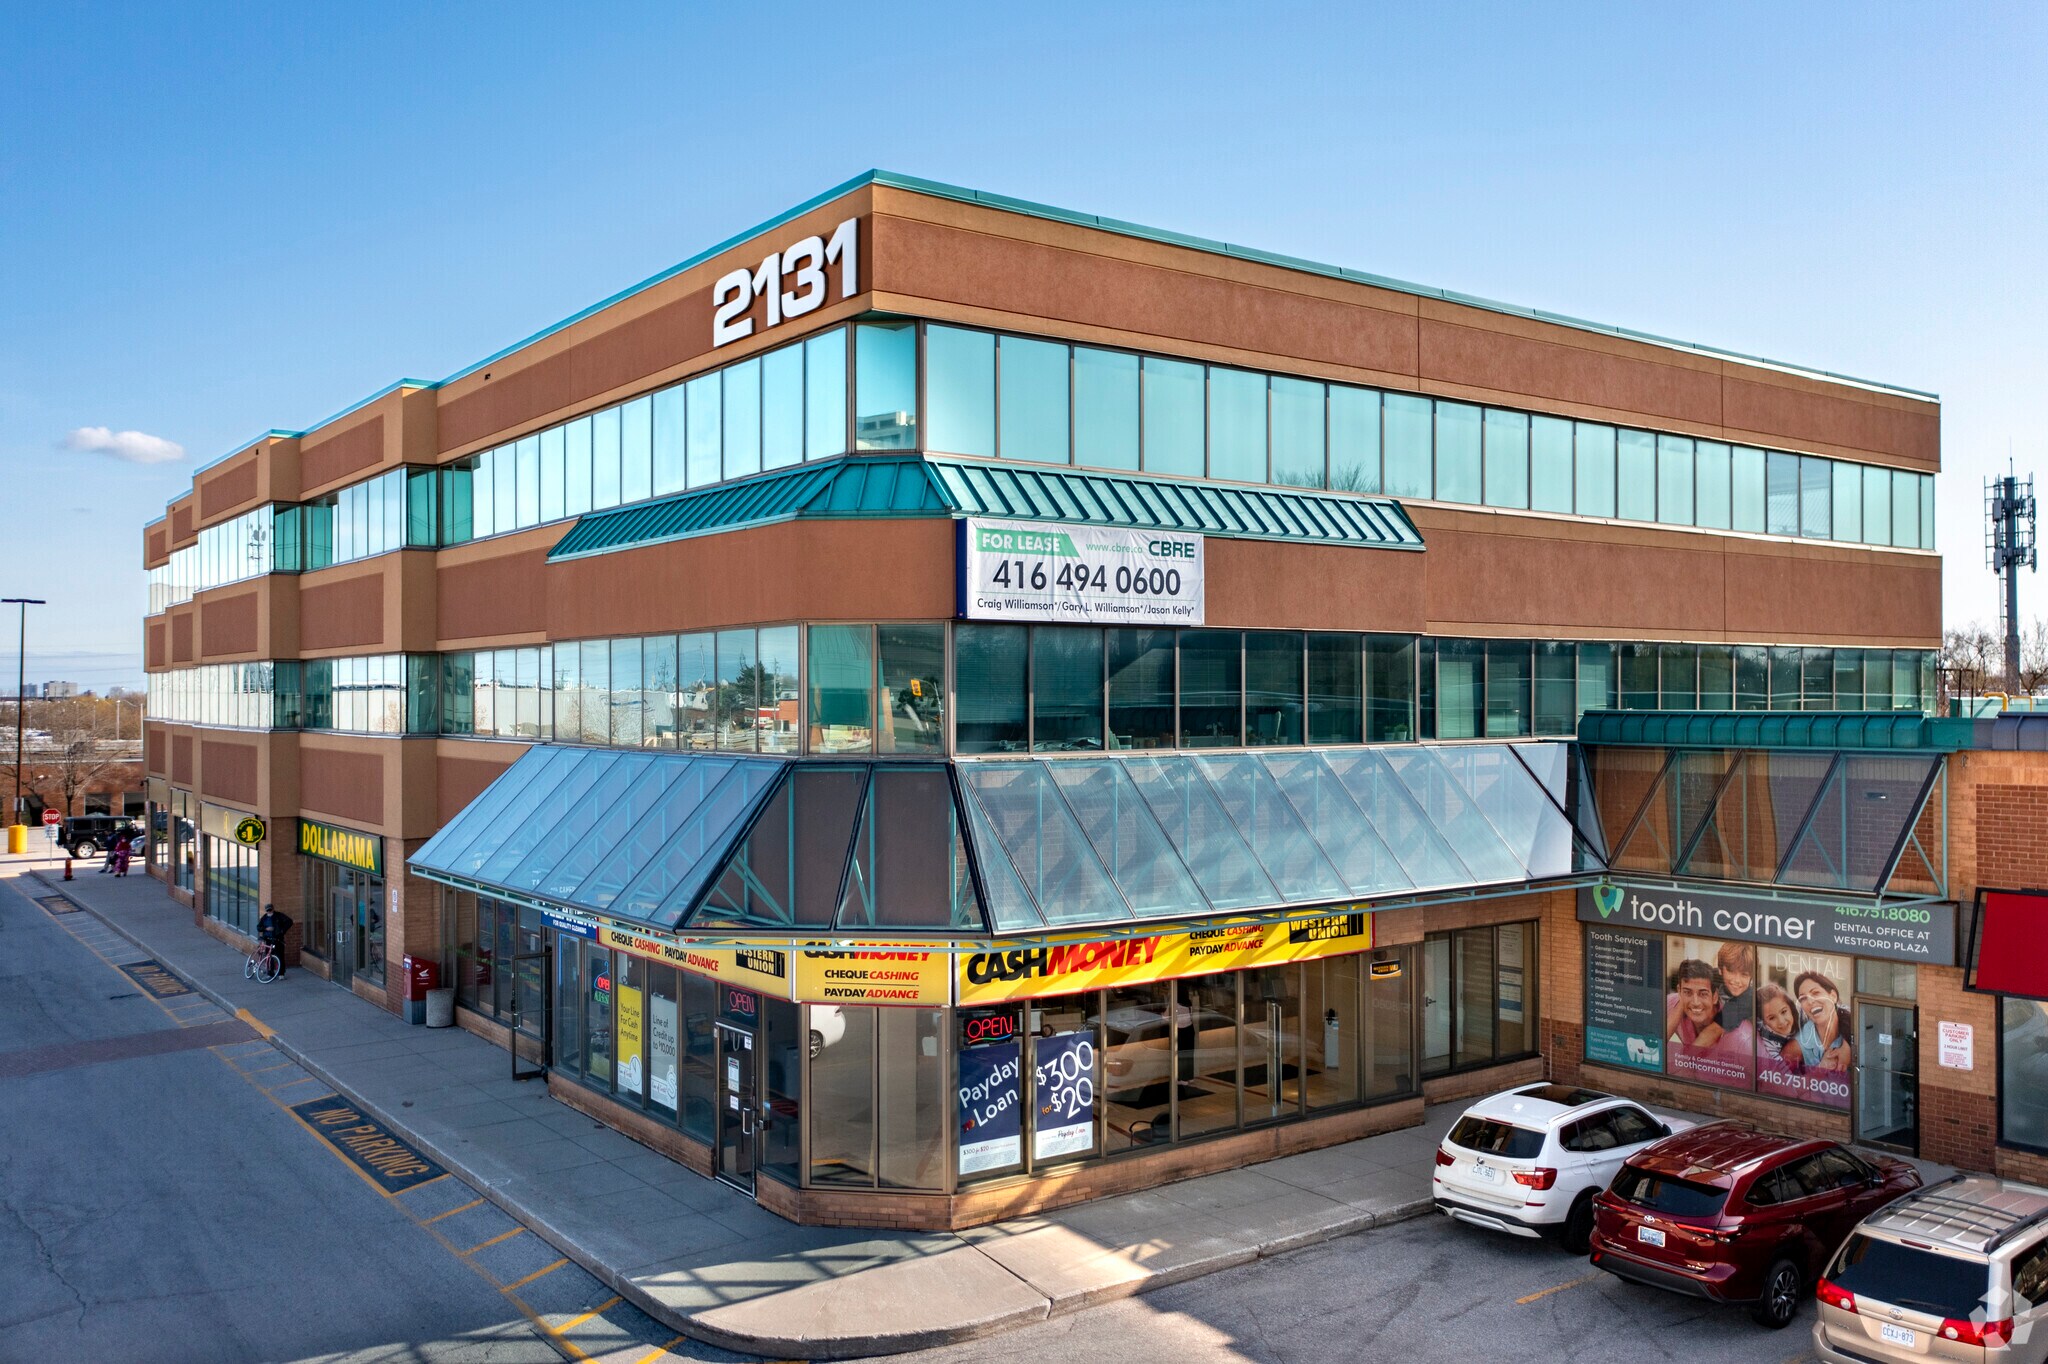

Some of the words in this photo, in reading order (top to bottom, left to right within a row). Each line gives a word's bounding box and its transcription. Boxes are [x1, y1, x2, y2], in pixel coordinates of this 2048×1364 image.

[713, 217, 858, 348] 2131
[982, 533, 1013, 549] FOR
[1017, 535, 1061, 552] LEASE
[1149, 540, 1195, 558] CBRE
[992, 560, 1047, 590] 416
[1056, 562, 1107, 593] 494
[1115, 565, 1181, 596] 0600
[977, 598, 1002, 611] Craig
[302, 823, 375, 871] DOLLARAMA
[1290, 914, 1348, 931] WESTERN
[1631, 895, 1702, 928] tooth
[1713, 909, 1815, 940] corner
[1189, 929, 1225, 940] CHEQUE
[1227, 924, 1264, 936] CASHING
[1308, 924, 1348, 940] UNION
[1590, 931, 1613, 942] Tooth
[1614, 934, 1648, 947] Services
[1834, 922, 1873, 934] DENTAL
[1876, 926, 1914, 938] OFFICE
[1917, 931, 1931, 940] AT
[611, 931, 633, 947] CHEQUE
[634, 938, 660, 955] CASHING
[664, 946, 687, 961] PAYDAY
[687, 953, 719, 972] ADVANCE
[1189, 944, 1224, 956] PAYDAY
[1224, 939, 1264, 952] ADVANCE
[1834, 935, 1891, 949] WESTFORD
[1894, 941, 1929, 953] PLAZA
[747, 957, 774, 974] UNION
[824, 969, 868, 979] CHEQUE
[869, 971, 919, 980] CASHING
[1775, 952, 1846, 980] DENTAL
[729, 991, 755, 1013] OPEN
[824, 988, 866, 997] PAYDAY
[866, 989, 919, 999] ADVANCE
[620, 1003, 630, 1014] Your
[630, 1006, 640, 1018] Line
[620, 1015, 628, 1024] For
[628, 1018, 638, 1029] Cash
[652, 1014, 663, 1026] Line
[967, 1015, 1013, 1038] OPEN
[620, 1028, 638, 1042] Anytime
[652, 1027, 668, 1040] Credit
[668, 1035, 674, 1044] up
[1035, 1040, 1094, 1092] $300
[1674, 1052, 1691, 1061] Family
[1697, 1056, 1720, 1066] Cosmetic
[1721, 1060, 1745, 1071] Dentistry
[1674, 1059, 1746, 1080] toothcorner.com
[959, 1056, 1019, 1108] Payday
[1759, 1069, 1849, 1097] 416.751.8080
[973, 1088, 1019, 1127] Loan
[1041, 1104, 1052, 1115] for
[1051, 1077, 1094, 1120] $20
[309, 1108, 361, 1125] NO
[331, 1124, 430, 1177] PARKING
